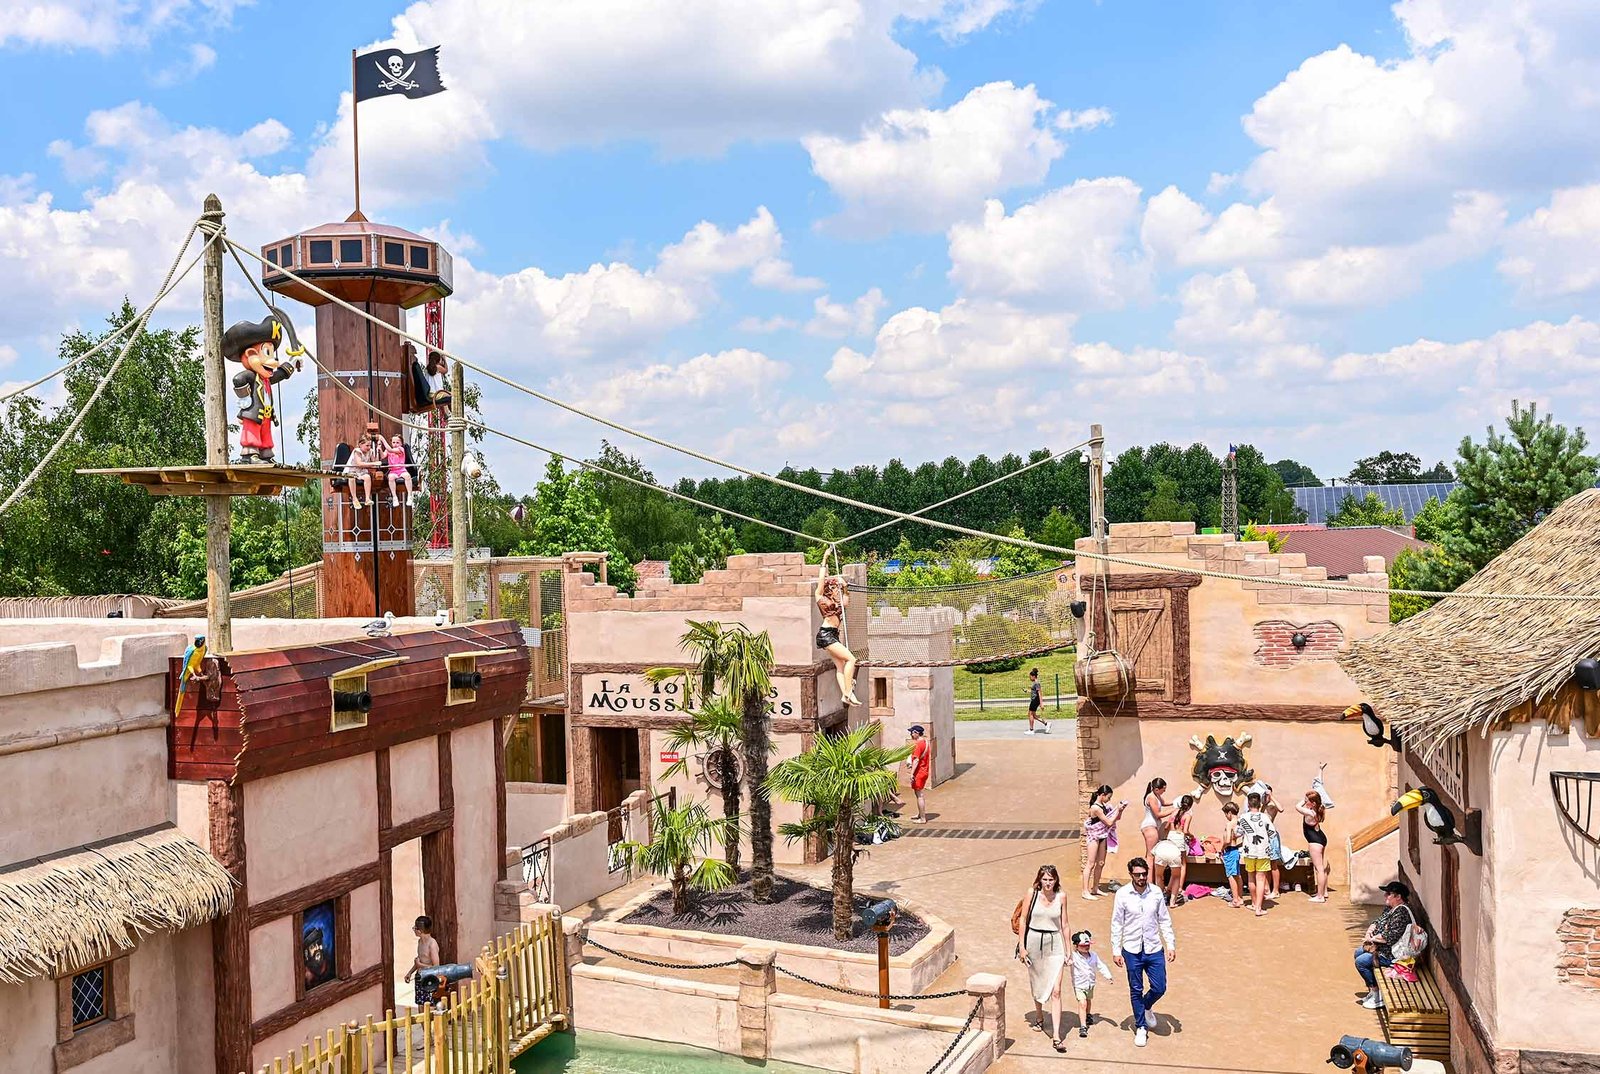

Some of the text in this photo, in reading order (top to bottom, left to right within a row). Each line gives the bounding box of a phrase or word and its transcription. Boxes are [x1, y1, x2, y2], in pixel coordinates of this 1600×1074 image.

[271, 320, 281, 340] K
[600, 680, 631, 694] LA
[588, 692, 792, 721] MOUSSS
